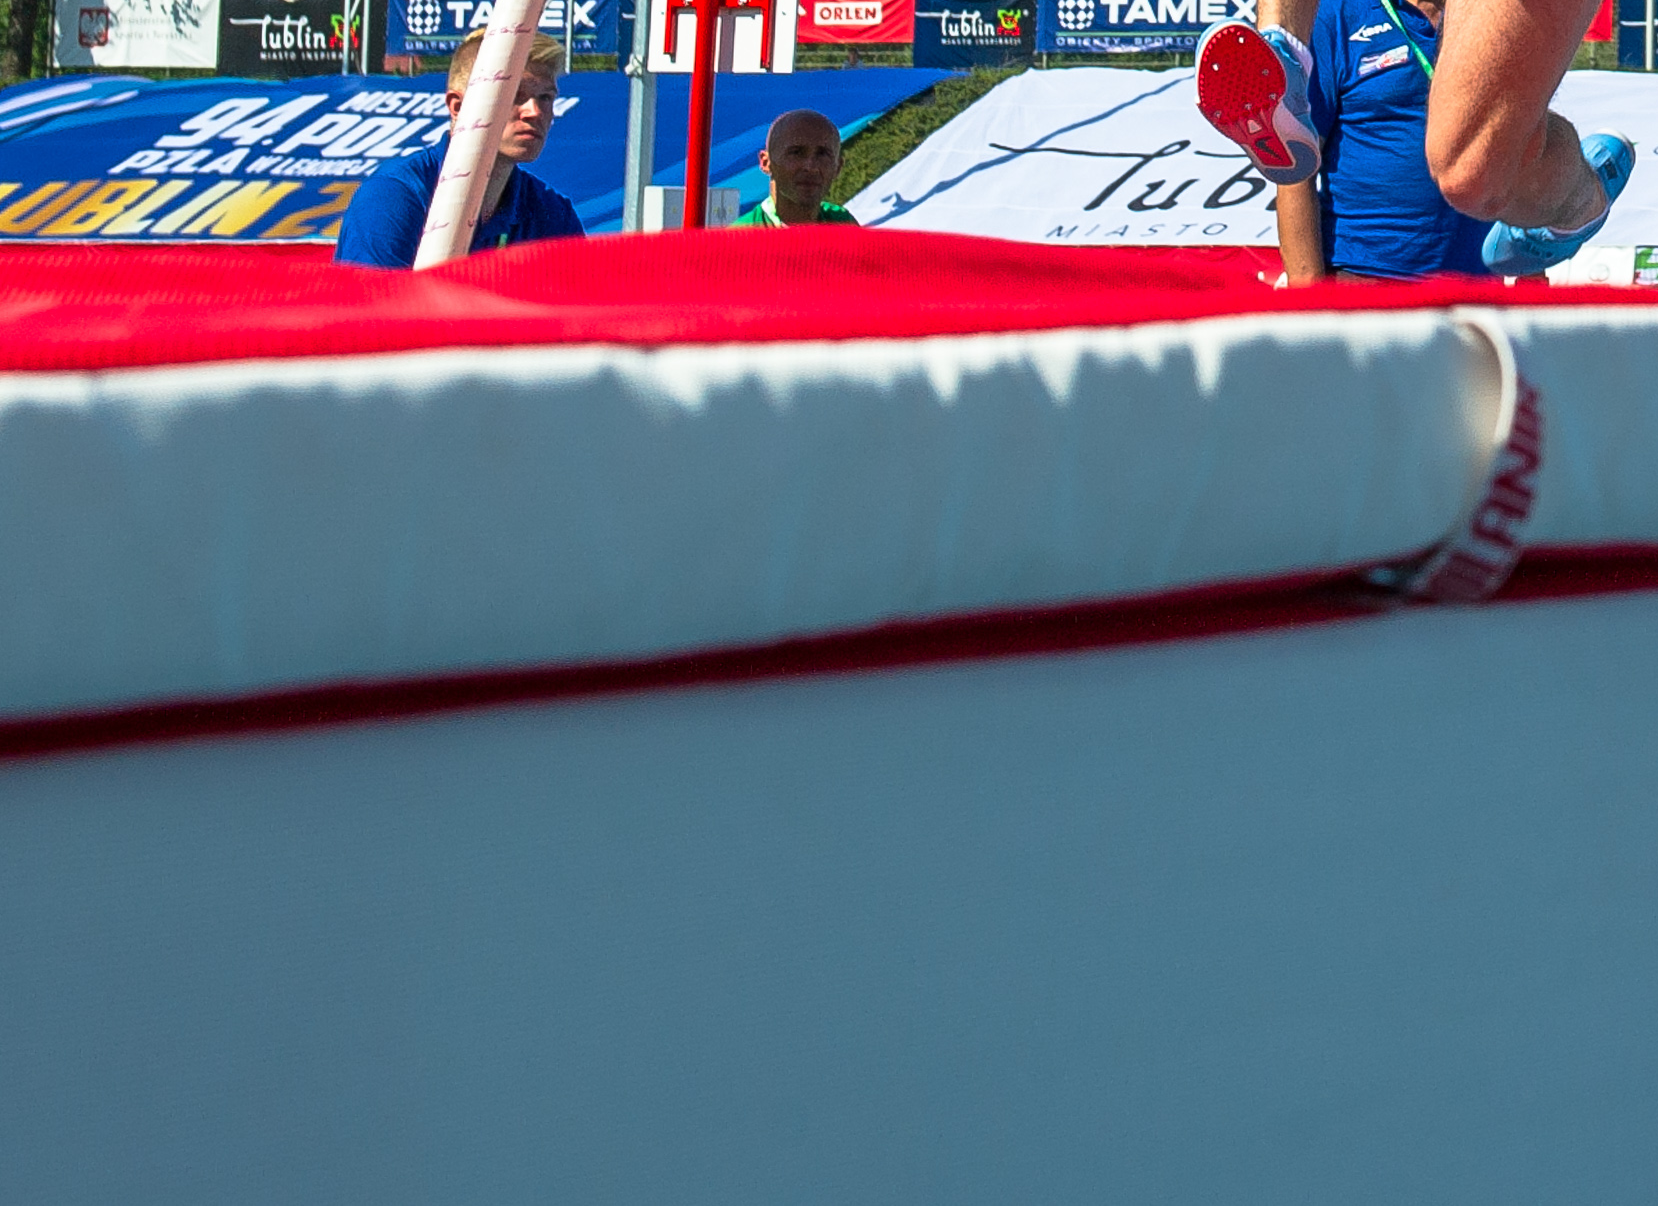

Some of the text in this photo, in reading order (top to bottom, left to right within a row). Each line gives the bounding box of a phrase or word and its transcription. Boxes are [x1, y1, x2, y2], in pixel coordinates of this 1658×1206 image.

[447, 0, 598, 29] TAEX
[819, 6, 876, 20] ORLEN
[916, 9, 995, 36] lublin
[229, 14, 327, 49] lublin
[1134, 36, 1200, 46] SPORTO
[107, 147, 251, 175] PZLA
[989, 140, 1278, 212] lub
[1045, 222, 1229, 239] MIASTO
